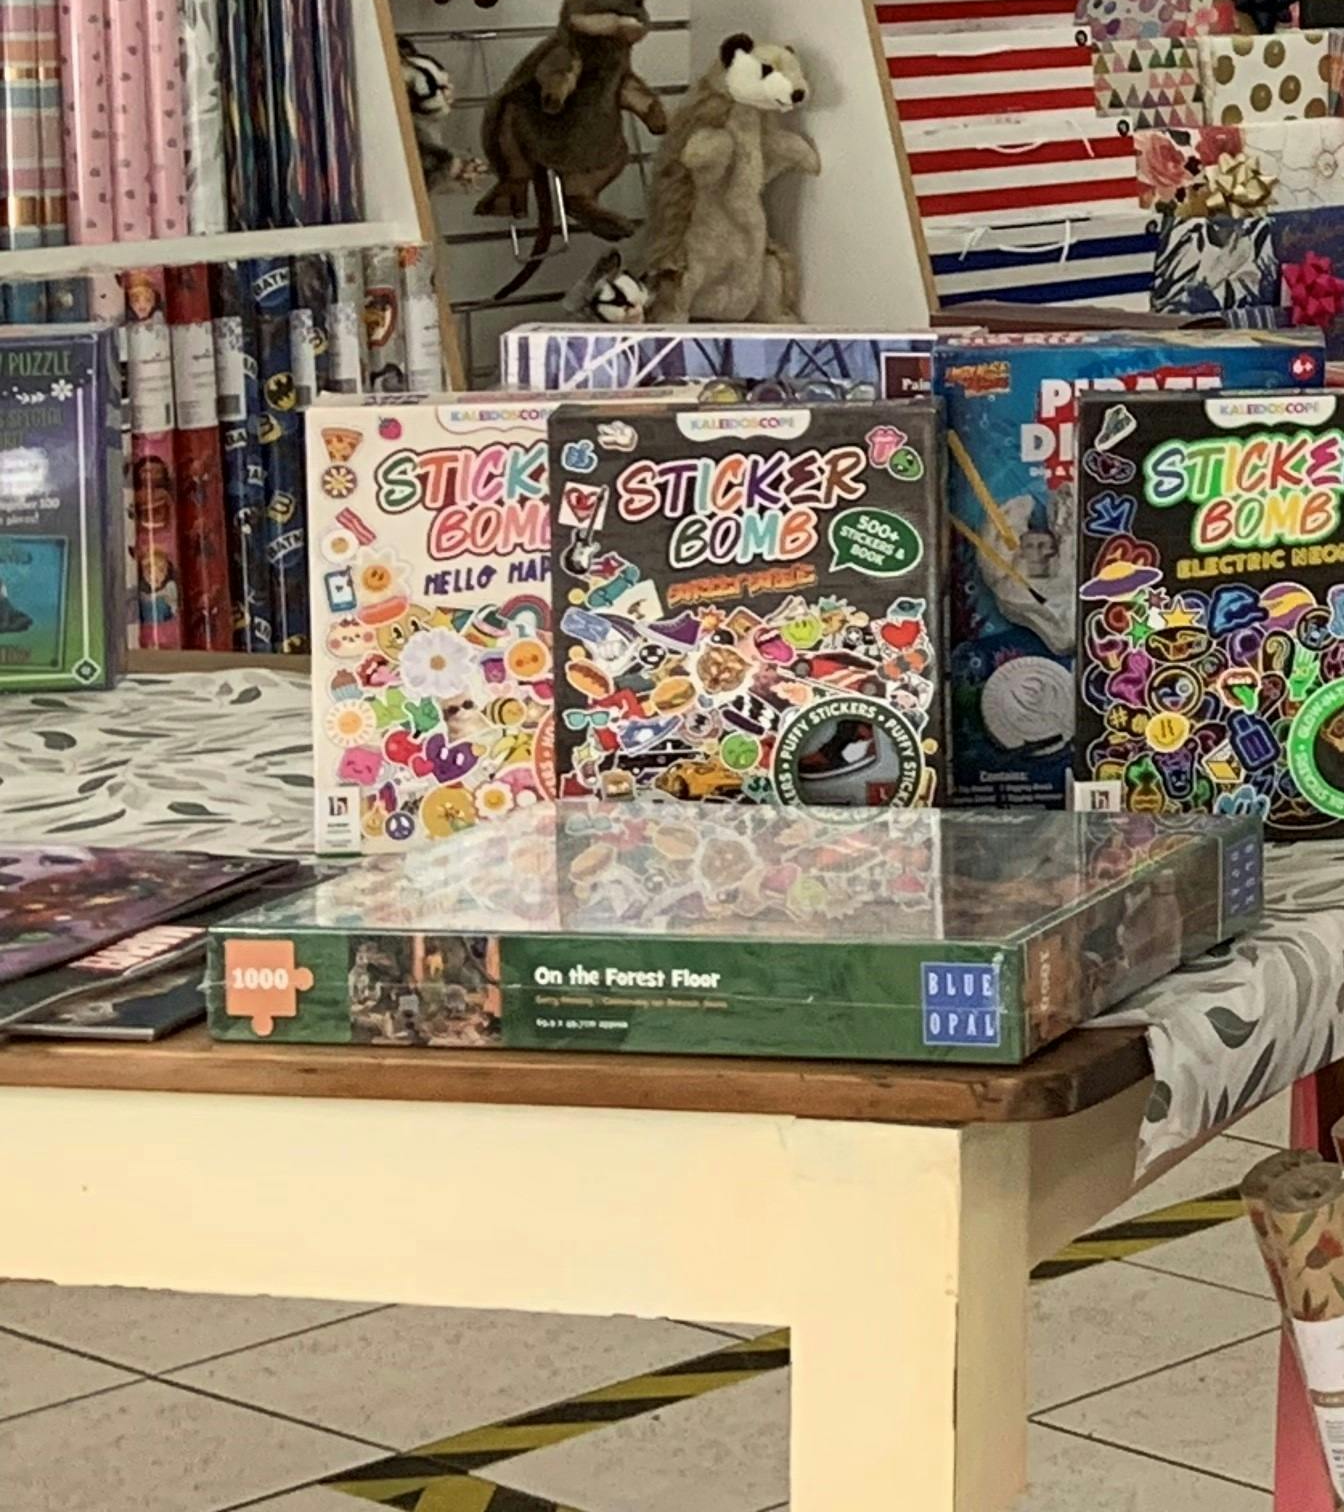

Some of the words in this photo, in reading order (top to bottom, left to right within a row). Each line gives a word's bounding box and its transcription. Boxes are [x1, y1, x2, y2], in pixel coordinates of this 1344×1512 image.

[7, 349, 73, 378] PUZZLE
[1218, 400, 1321, 416] KALEIDOSCOPE
[690, 416, 797, 431] KALEIDOSCOPE
[375, 438, 549, 515] STICK
[616, 445, 867, 521] STICKER
[856, 514, 901, 543] 500+
[1198, 492, 1337, 549] BOMB
[669, 506, 819, 569] BOMB
[838, 525, 896, 558] STICKERS
[849, 545, 888, 566] BOOK
[1175, 548, 1287, 580] ELECTRIC
[423, 563, 498, 597] HELLO
[780, 718, 811, 760] PUFFY
[808, 701, 878, 726] STICKERS
[884, 717, 916, 757] PUFFY
[231, 968, 290, 990] 1000
[533, 965, 563, 986] On
[568, 963, 600, 986] the
[604, 967, 666, 988] Forest
[671, 968, 722, 989] Floor
[927, 970, 994, 997] BLUE
[929, 1013, 996, 1038] OPAL
